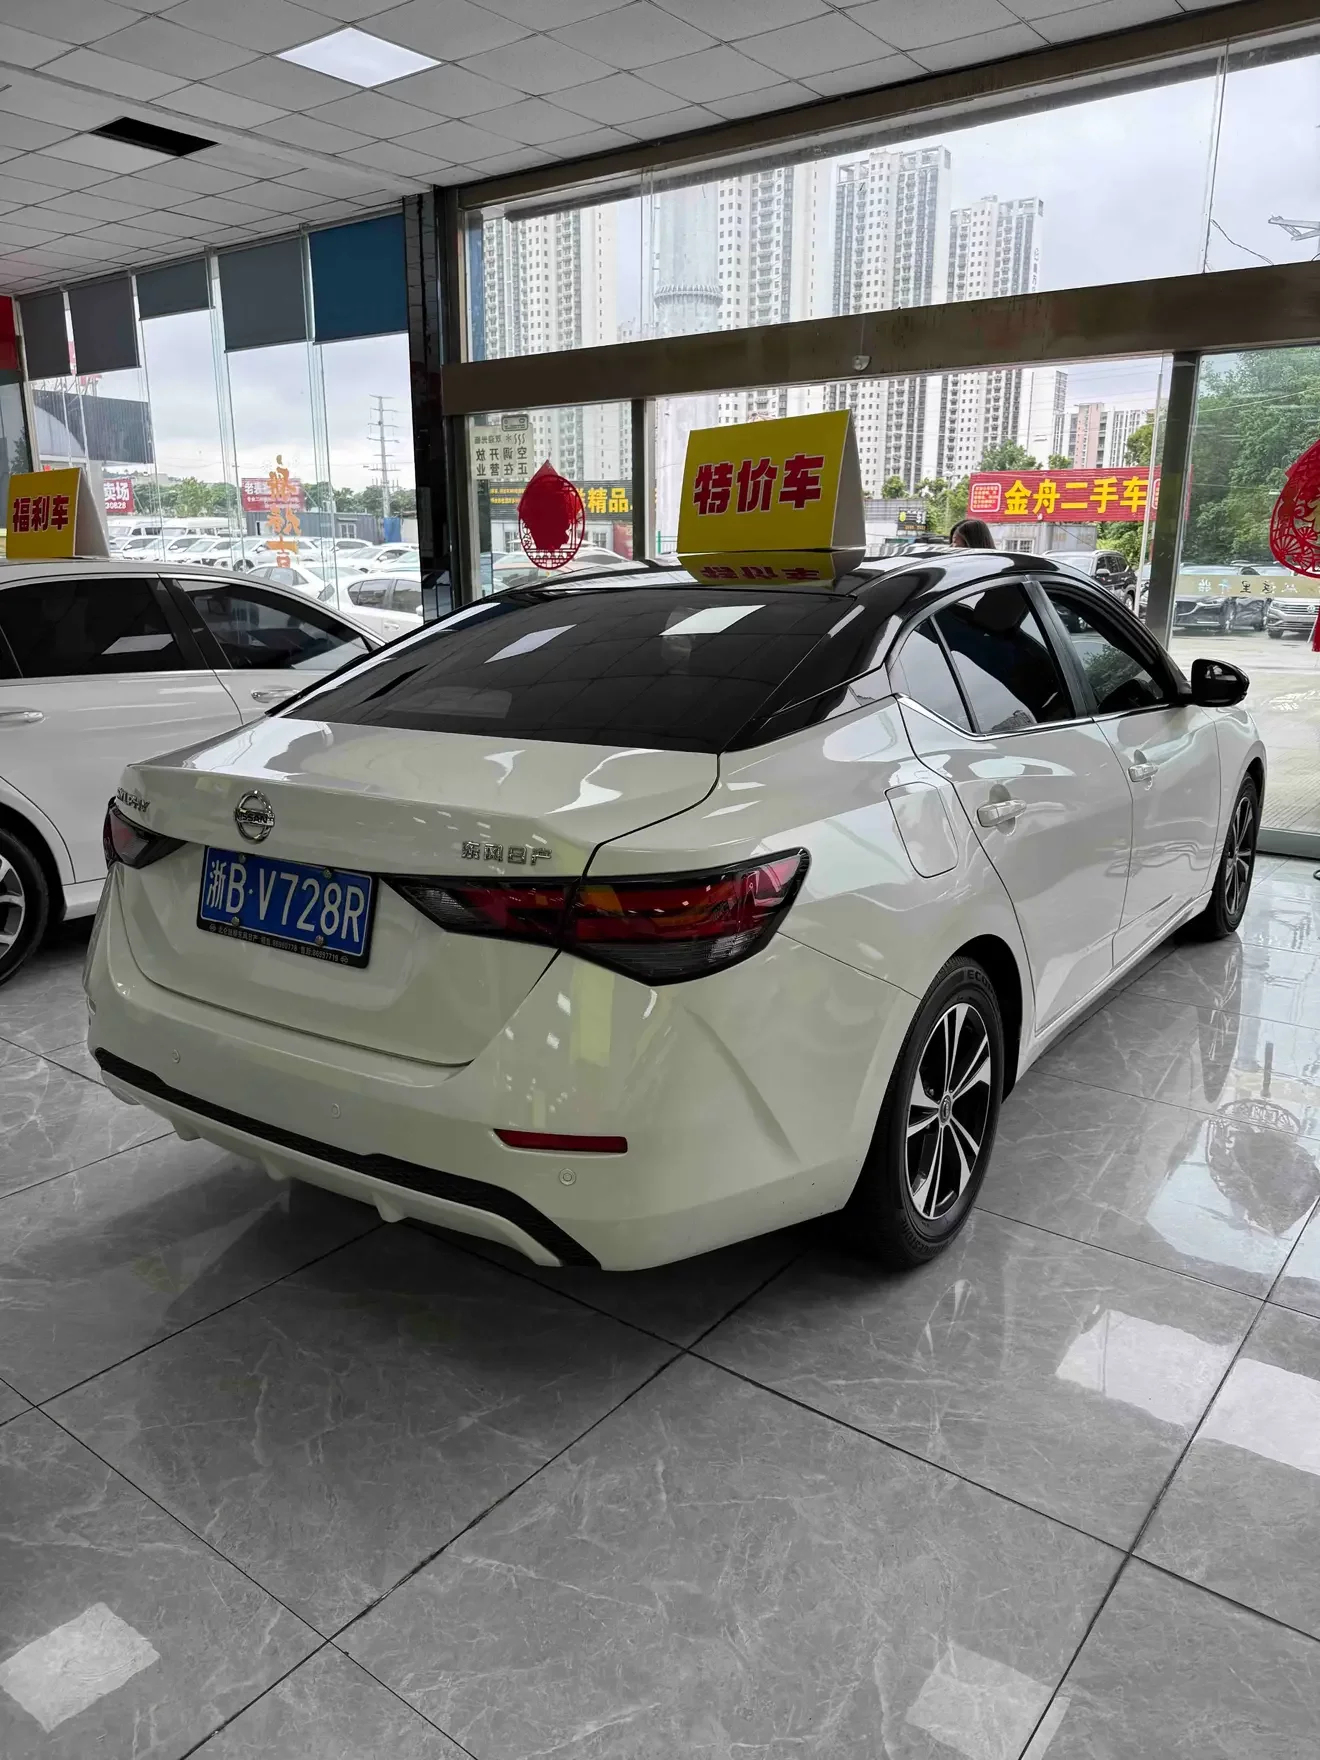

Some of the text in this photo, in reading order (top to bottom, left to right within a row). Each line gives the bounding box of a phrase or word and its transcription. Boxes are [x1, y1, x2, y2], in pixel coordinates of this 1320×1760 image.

[693, 453, 826, 517] 特价车
[1003, 475, 1149, 515] 金舟二手车
[12, 494, 70, 533] 福利车
[236, 808, 272, 826] NISSAN
[461, 840, 553, 867] 东风日产
[206, 859, 365, 943] 浙B·V728R
